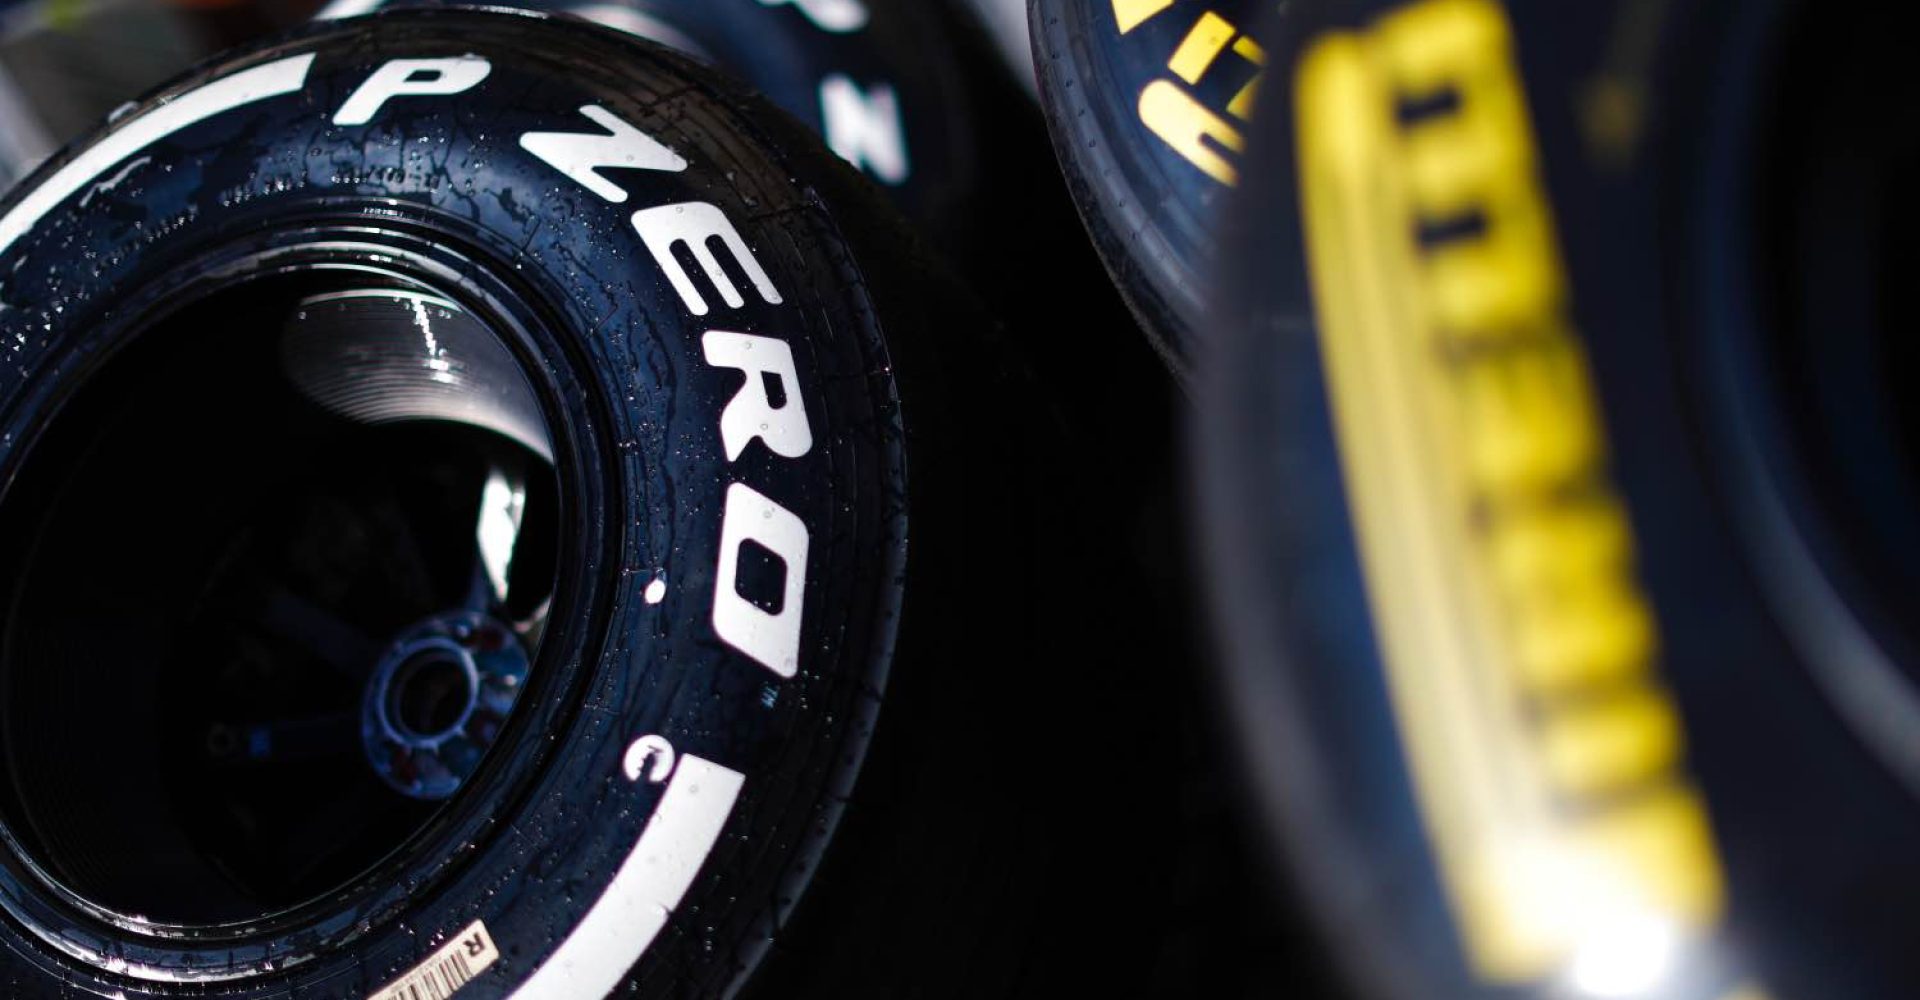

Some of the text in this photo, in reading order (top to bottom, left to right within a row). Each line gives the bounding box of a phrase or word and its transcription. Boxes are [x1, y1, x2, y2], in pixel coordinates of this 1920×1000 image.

[332, 53, 491, 126] P
[519, 104, 812, 678] ZERO
[463, 931, 486, 957] R
